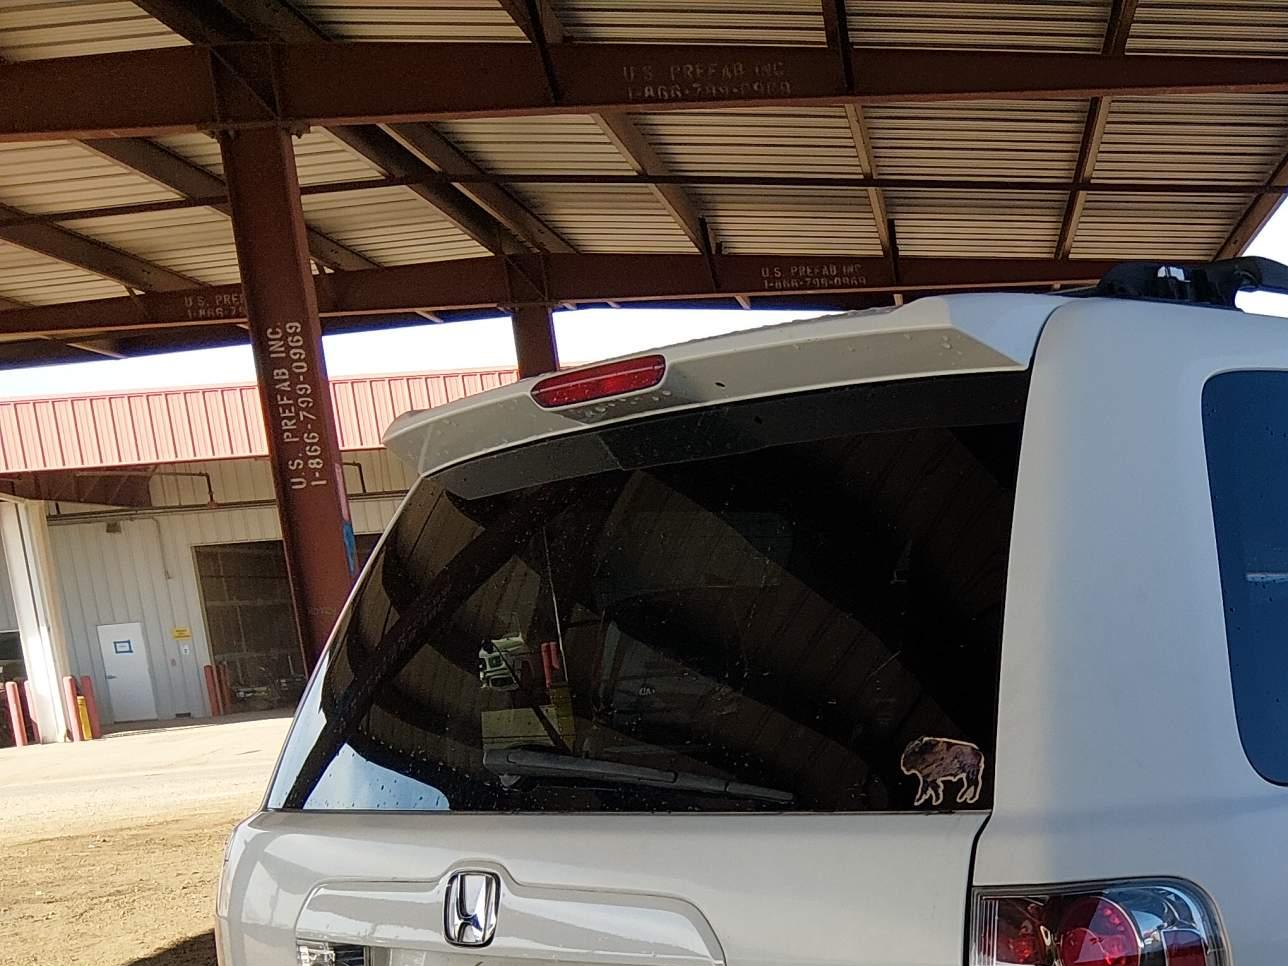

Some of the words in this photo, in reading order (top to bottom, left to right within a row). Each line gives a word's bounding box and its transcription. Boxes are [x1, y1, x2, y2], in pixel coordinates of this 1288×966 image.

[790, 263, 837, 277] PREFAB
[273, 367, 300, 443] PREFAB
[285, 321, 328, 486] 1-866-799-0969
[288, 452, 307, 490] U.S.
